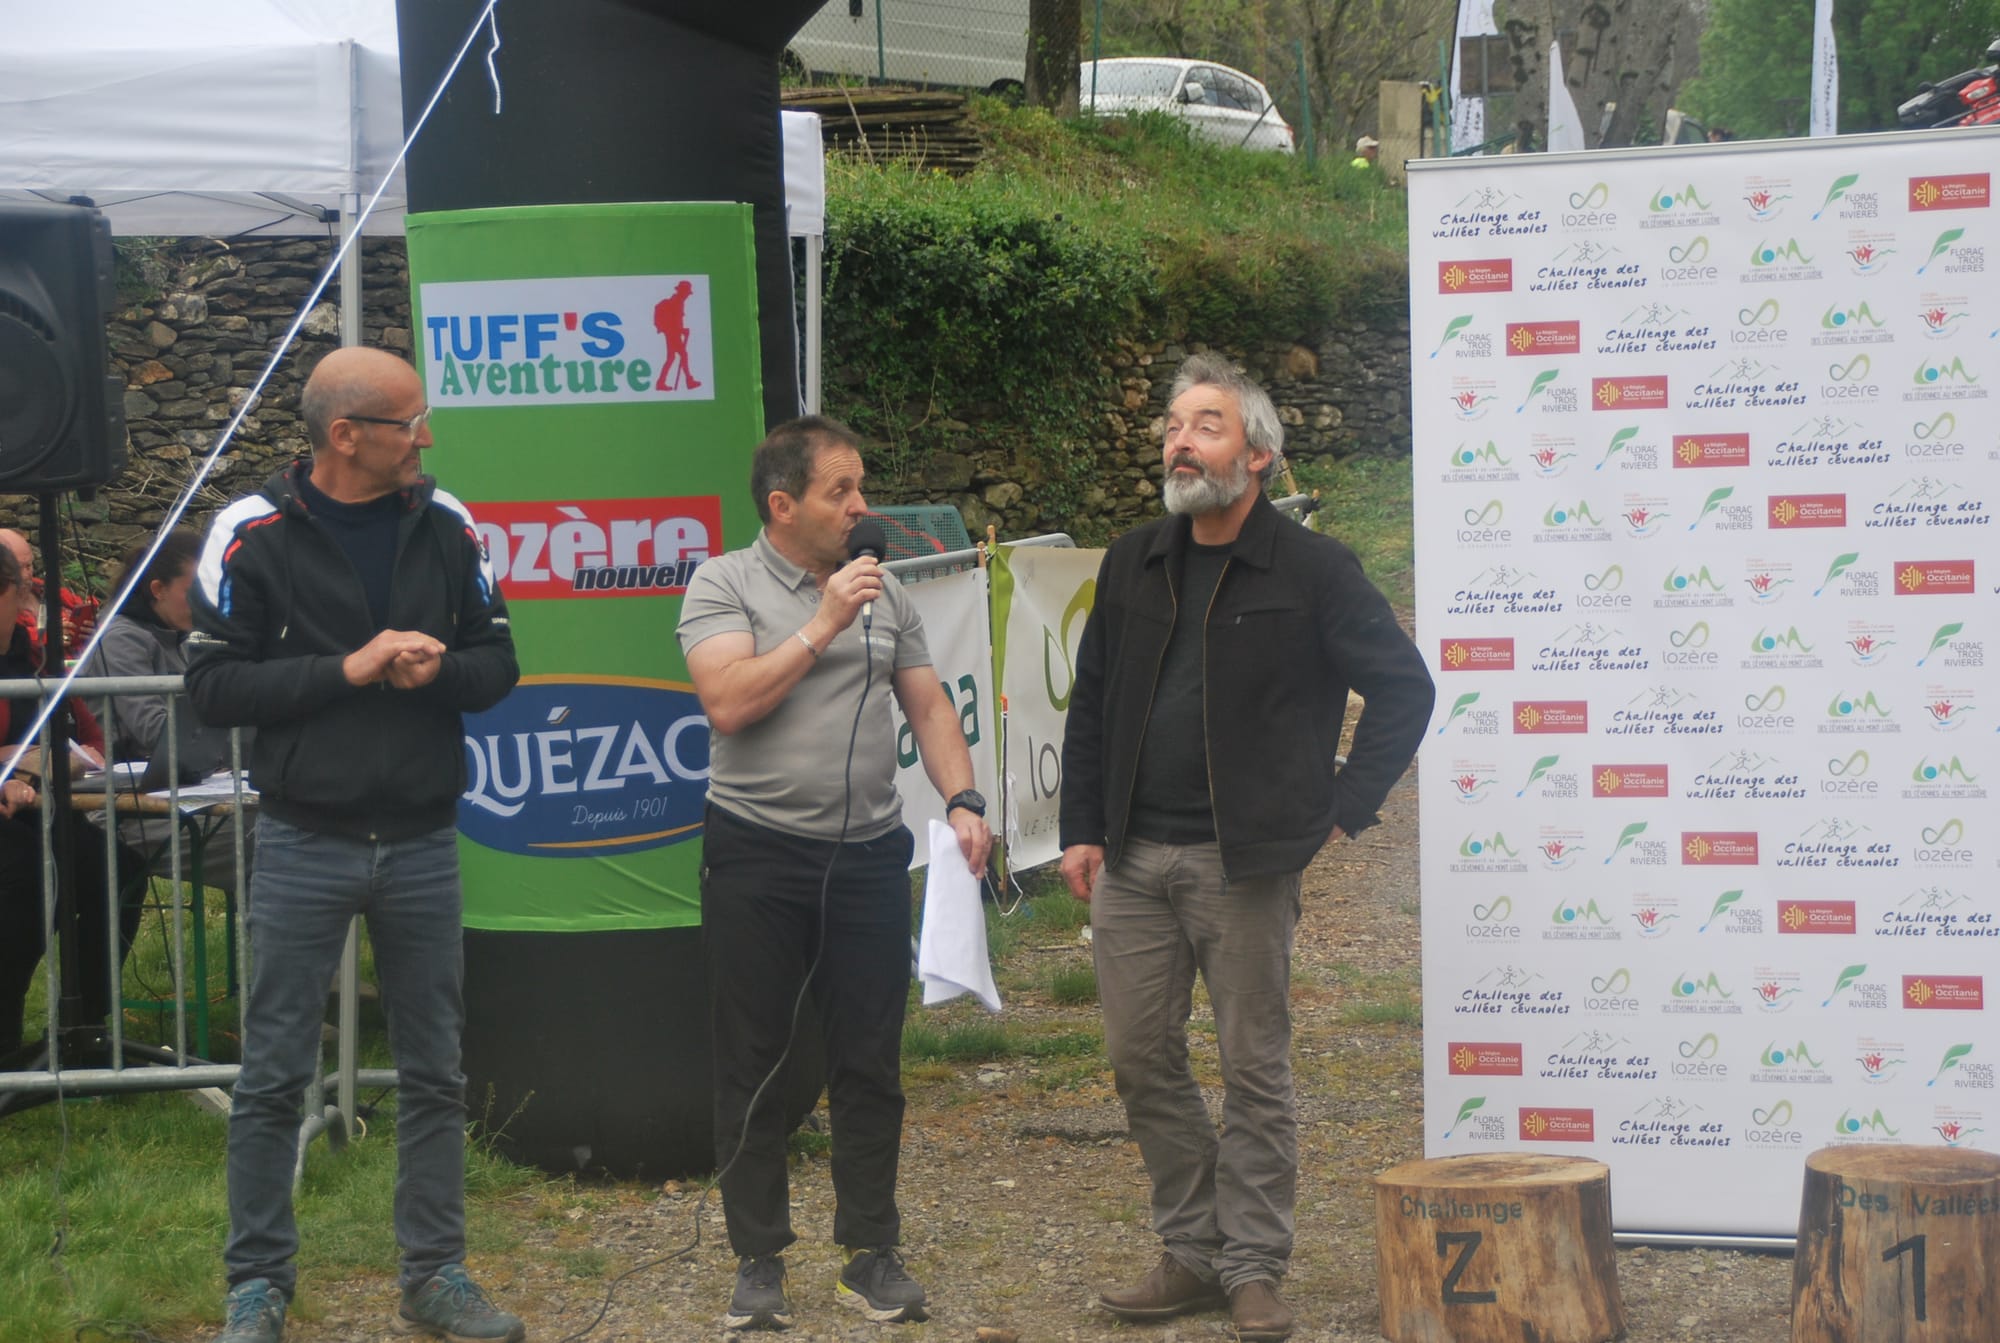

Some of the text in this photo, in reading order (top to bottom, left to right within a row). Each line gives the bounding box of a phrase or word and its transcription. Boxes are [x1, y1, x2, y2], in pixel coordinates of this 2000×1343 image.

[1844, 193, 1878, 201] FLORAC
[1942, 187, 1985, 196] Occitanie
[1852, 201, 1877, 209] TROIS
[1439, 210, 1540, 227] Challenge des
[1561, 211, 1616, 226] lozère
[1432, 222, 1547, 237] vallées cévenoles
[1949, 247, 1984, 255] FLORAC
[1958, 256, 1983, 264] TROIS
[1468, 271, 1508, 280] Occitanie
[1537, 264, 1639, 281] Challenge des
[1661, 264, 1717, 280] lozère
[1529, 276, 1646, 291] vallées cévenoles
[427, 312, 625, 361] TUFF'S
[1460, 333, 1491, 341] FLORAC
[1536, 333, 1576, 342] Occitanie
[1605, 326, 1709, 343] Challenge des
[1730, 327, 1787, 342] lozère
[1467, 341, 1491, 349] TROIS
[1597, 338, 1716, 353] vallées cévenoles
[440, 351, 652, 396] Aventure
[1546, 387, 1577, 395] FLORAC
[1623, 388, 1664, 396] Occitanie
[1693, 381, 1798, 398] Challenge des
[1821, 383, 1878, 398] lozère
[1685, 394, 1806, 408] vallées cévenoles
[1625, 445, 1657, 453] FLORAC
[1704, 446, 1745, 454] Occitanie
[1775, 440, 1882, 456] Challenge des
[1905, 441, 1964, 456] lozère
[1633, 453, 1657, 461] TROIS
[1767, 452, 1890, 466] vallées cévenoles
[1720, 505, 1752, 513] FLORAC
[1800, 506, 1842, 515] Occitanie
[1873, 501, 1981, 517] Challenge des
[1864, 513, 1989, 527] vallées cévenoles
[1456, 527, 1511, 542] lozère
[477, 506, 709, 582] ozère
[572, 557, 698, 592] nouvell
[1845, 571, 1878, 579] FLORAC
[1926, 573, 1970, 581] Occitanie
[1853, 580, 1878, 588] TROIS
[1454, 589, 1555, 604] Challenge des
[1576, 593, 1631, 607] lozère
[1446, 601, 1562, 613] vallées cévenoles
[1470, 650, 1510, 658] Occitanie
[1539, 646, 1641, 661] Challenge des
[1662, 650, 1717, 663] lozère
[1531, 659, 1648, 670] vallées cévenoles
[1467, 710, 1498, 718] FLORAC
[1543, 713, 1584, 721] Occitanie
[1612, 710, 1716, 724] Challenge des
[1737, 713, 1794, 727] lozère
[1604, 722, 1723, 733] vallées cévenoles
[1693, 774, 1798, 788] Challenge des
[1820, 778, 1878, 792] lozère
[1685, 787, 1806, 798] vallées cévenoles
[571, 796, 668, 830] Depuis 1901
[1713, 844, 1755, 852] Occitanie
[1784, 842, 1891, 856] Challenge des
[1913, 847, 1972, 861] lozère
[1776, 855, 1898, 866] vallées cévenoles
[1809, 913, 1852, 921] Occitanie
[1882, 911, 1991, 927] Challenge des
[1465, 923, 1520, 937] lozère
[1874, 924, 2000, 937] vallées cévenoles
[1853, 983, 1887, 991] FLORAC
[1935, 988, 1979, 997] Occitanie
[1461, 989, 1562, 1003] Challenge des
[1583, 996, 1639, 1010] lozère
[1861, 992, 1886, 1000] TROIS
[1454, 1001, 1569, 1014] vallées cévenoles
[1478, 1055, 1518, 1063] Occitanie
[1547, 1054, 1649, 1068] Challenge des
[1539, 1066, 1657, 1079] vallées cévenoles
[1670, 1061, 1727, 1075] lozère
[1959, 1063, 1993, 1071] FLORAC
[1967, 1072, 1993, 1080] TROIS
[1473, 1115, 1504, 1123] FLORAC
[1549, 1121, 1590, 1129] Occitanie
[1619, 1120, 1723, 1135] Challenge des
[1611, 1132, 1730, 1146] vallées cévenoles
[1744, 1128, 1801, 1143] lozère
[1838, 1184, 1889, 1213] Des
[1400, 1195, 1523, 1224] Challenge
[1882, 1234, 1927, 1322] 1
